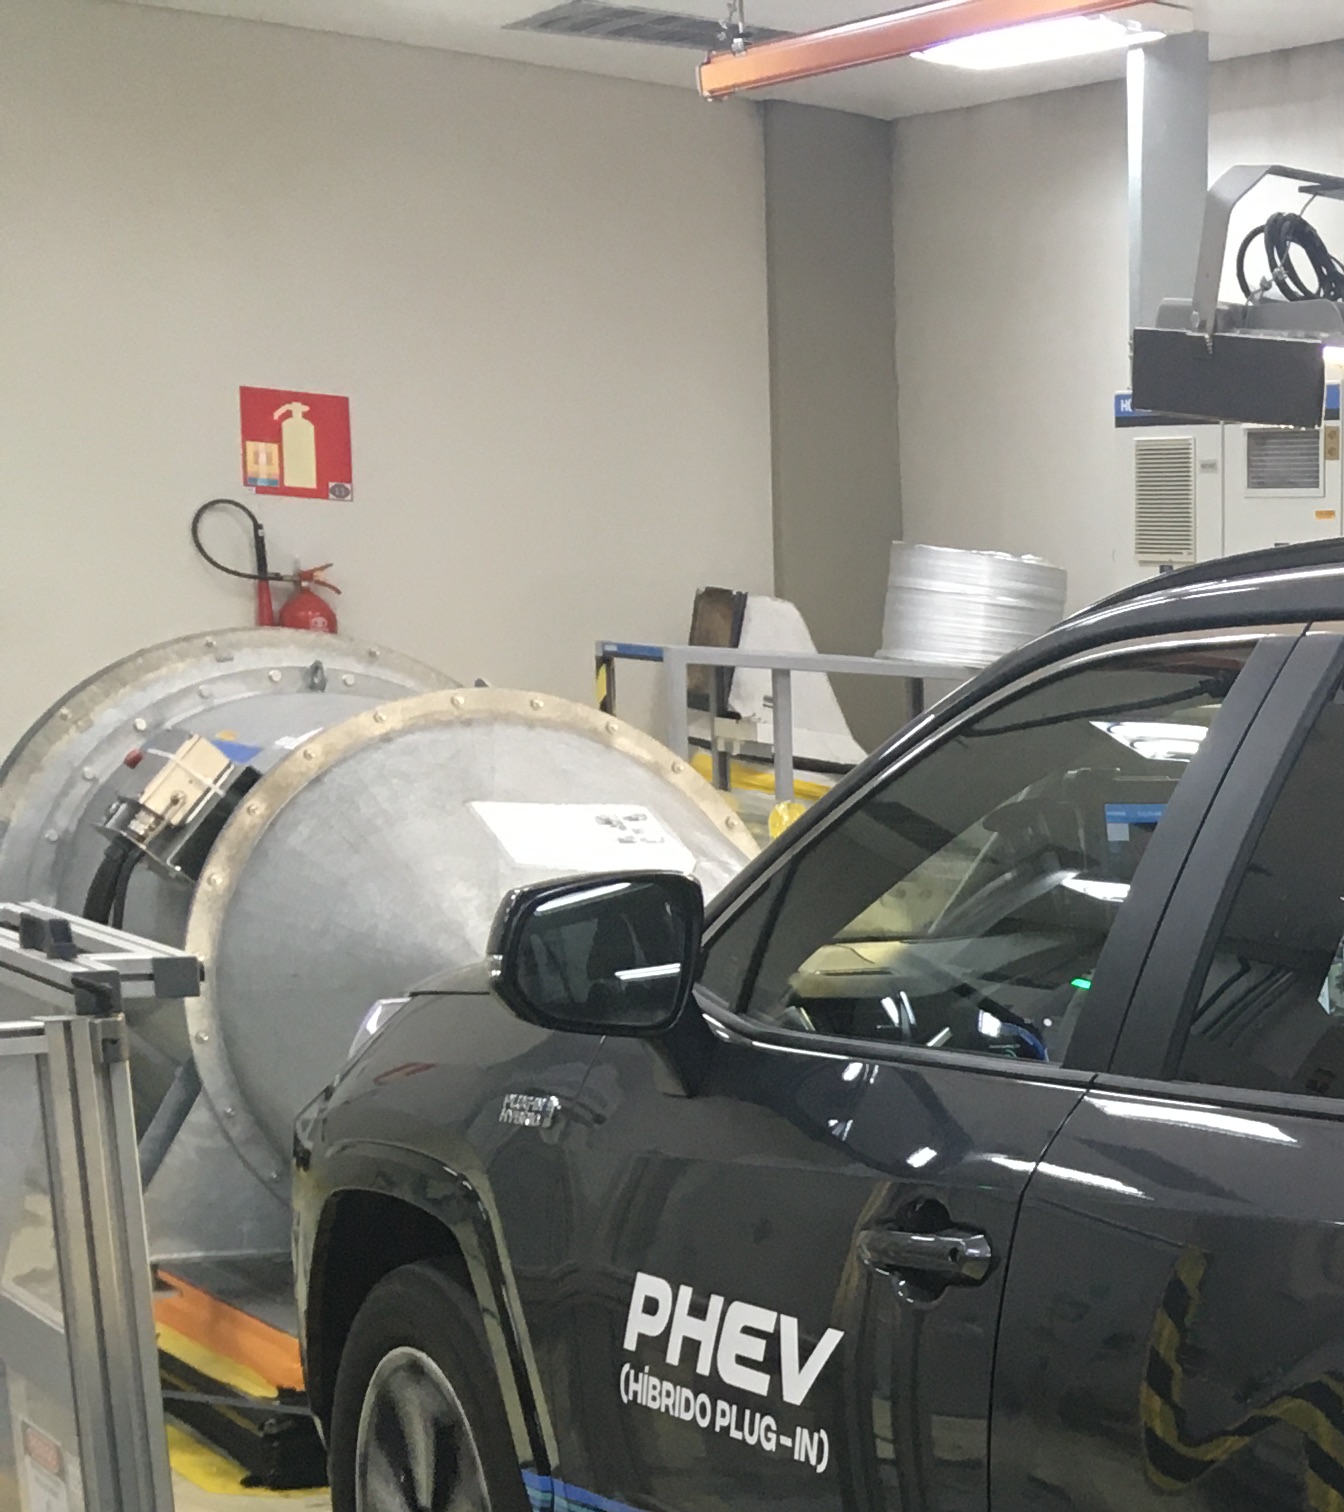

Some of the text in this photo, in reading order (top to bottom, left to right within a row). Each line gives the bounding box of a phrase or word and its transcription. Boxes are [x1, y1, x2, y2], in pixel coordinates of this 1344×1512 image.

[623, 1271, 844, 1406] PHEV
[620, 1362, 830, 1473] (HÍBRIDO PLUG-IN)
